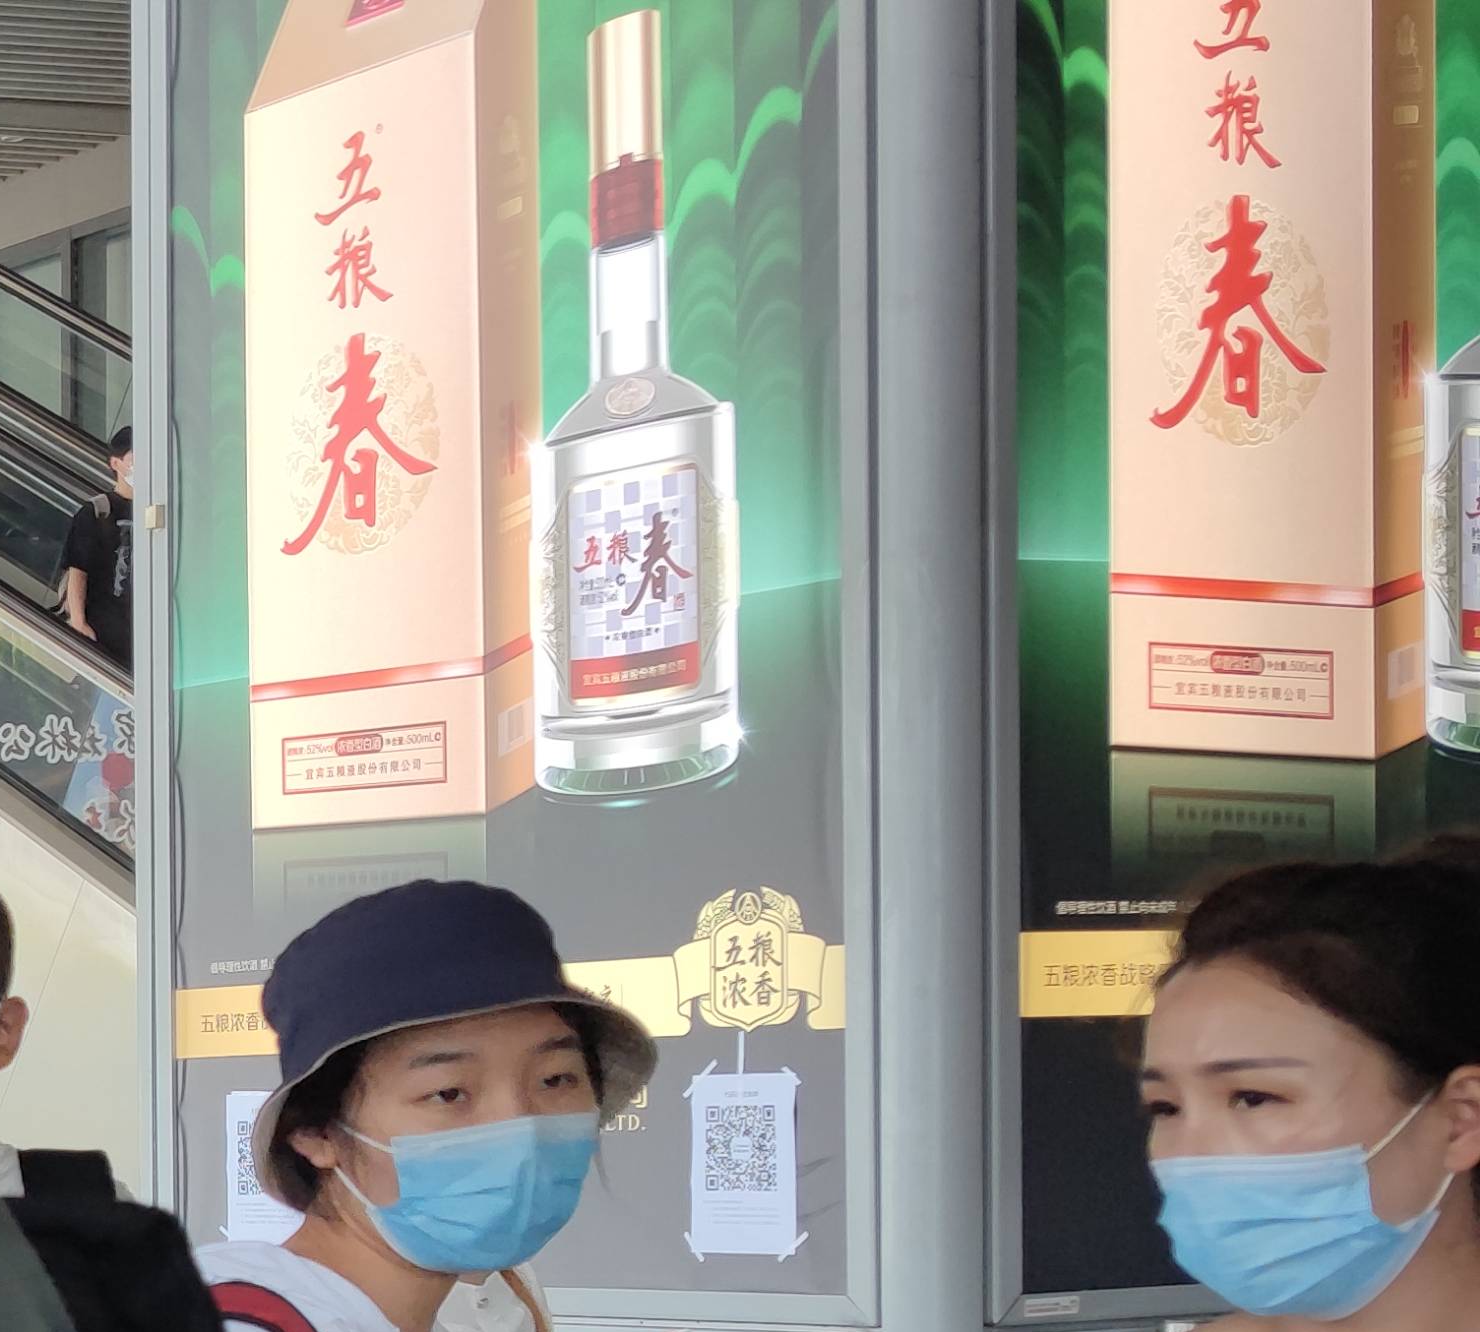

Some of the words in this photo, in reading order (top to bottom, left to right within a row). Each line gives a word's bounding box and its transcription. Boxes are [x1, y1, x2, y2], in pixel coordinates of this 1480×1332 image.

[281, 130, 438, 556] 五粮春
[573, 511, 694, 617] 五粮春
[711, 931, 783, 971] 五粮
[722, 971, 781, 1009] 浓香
[1043, 963, 1166, 986] 五粮浓香战略
